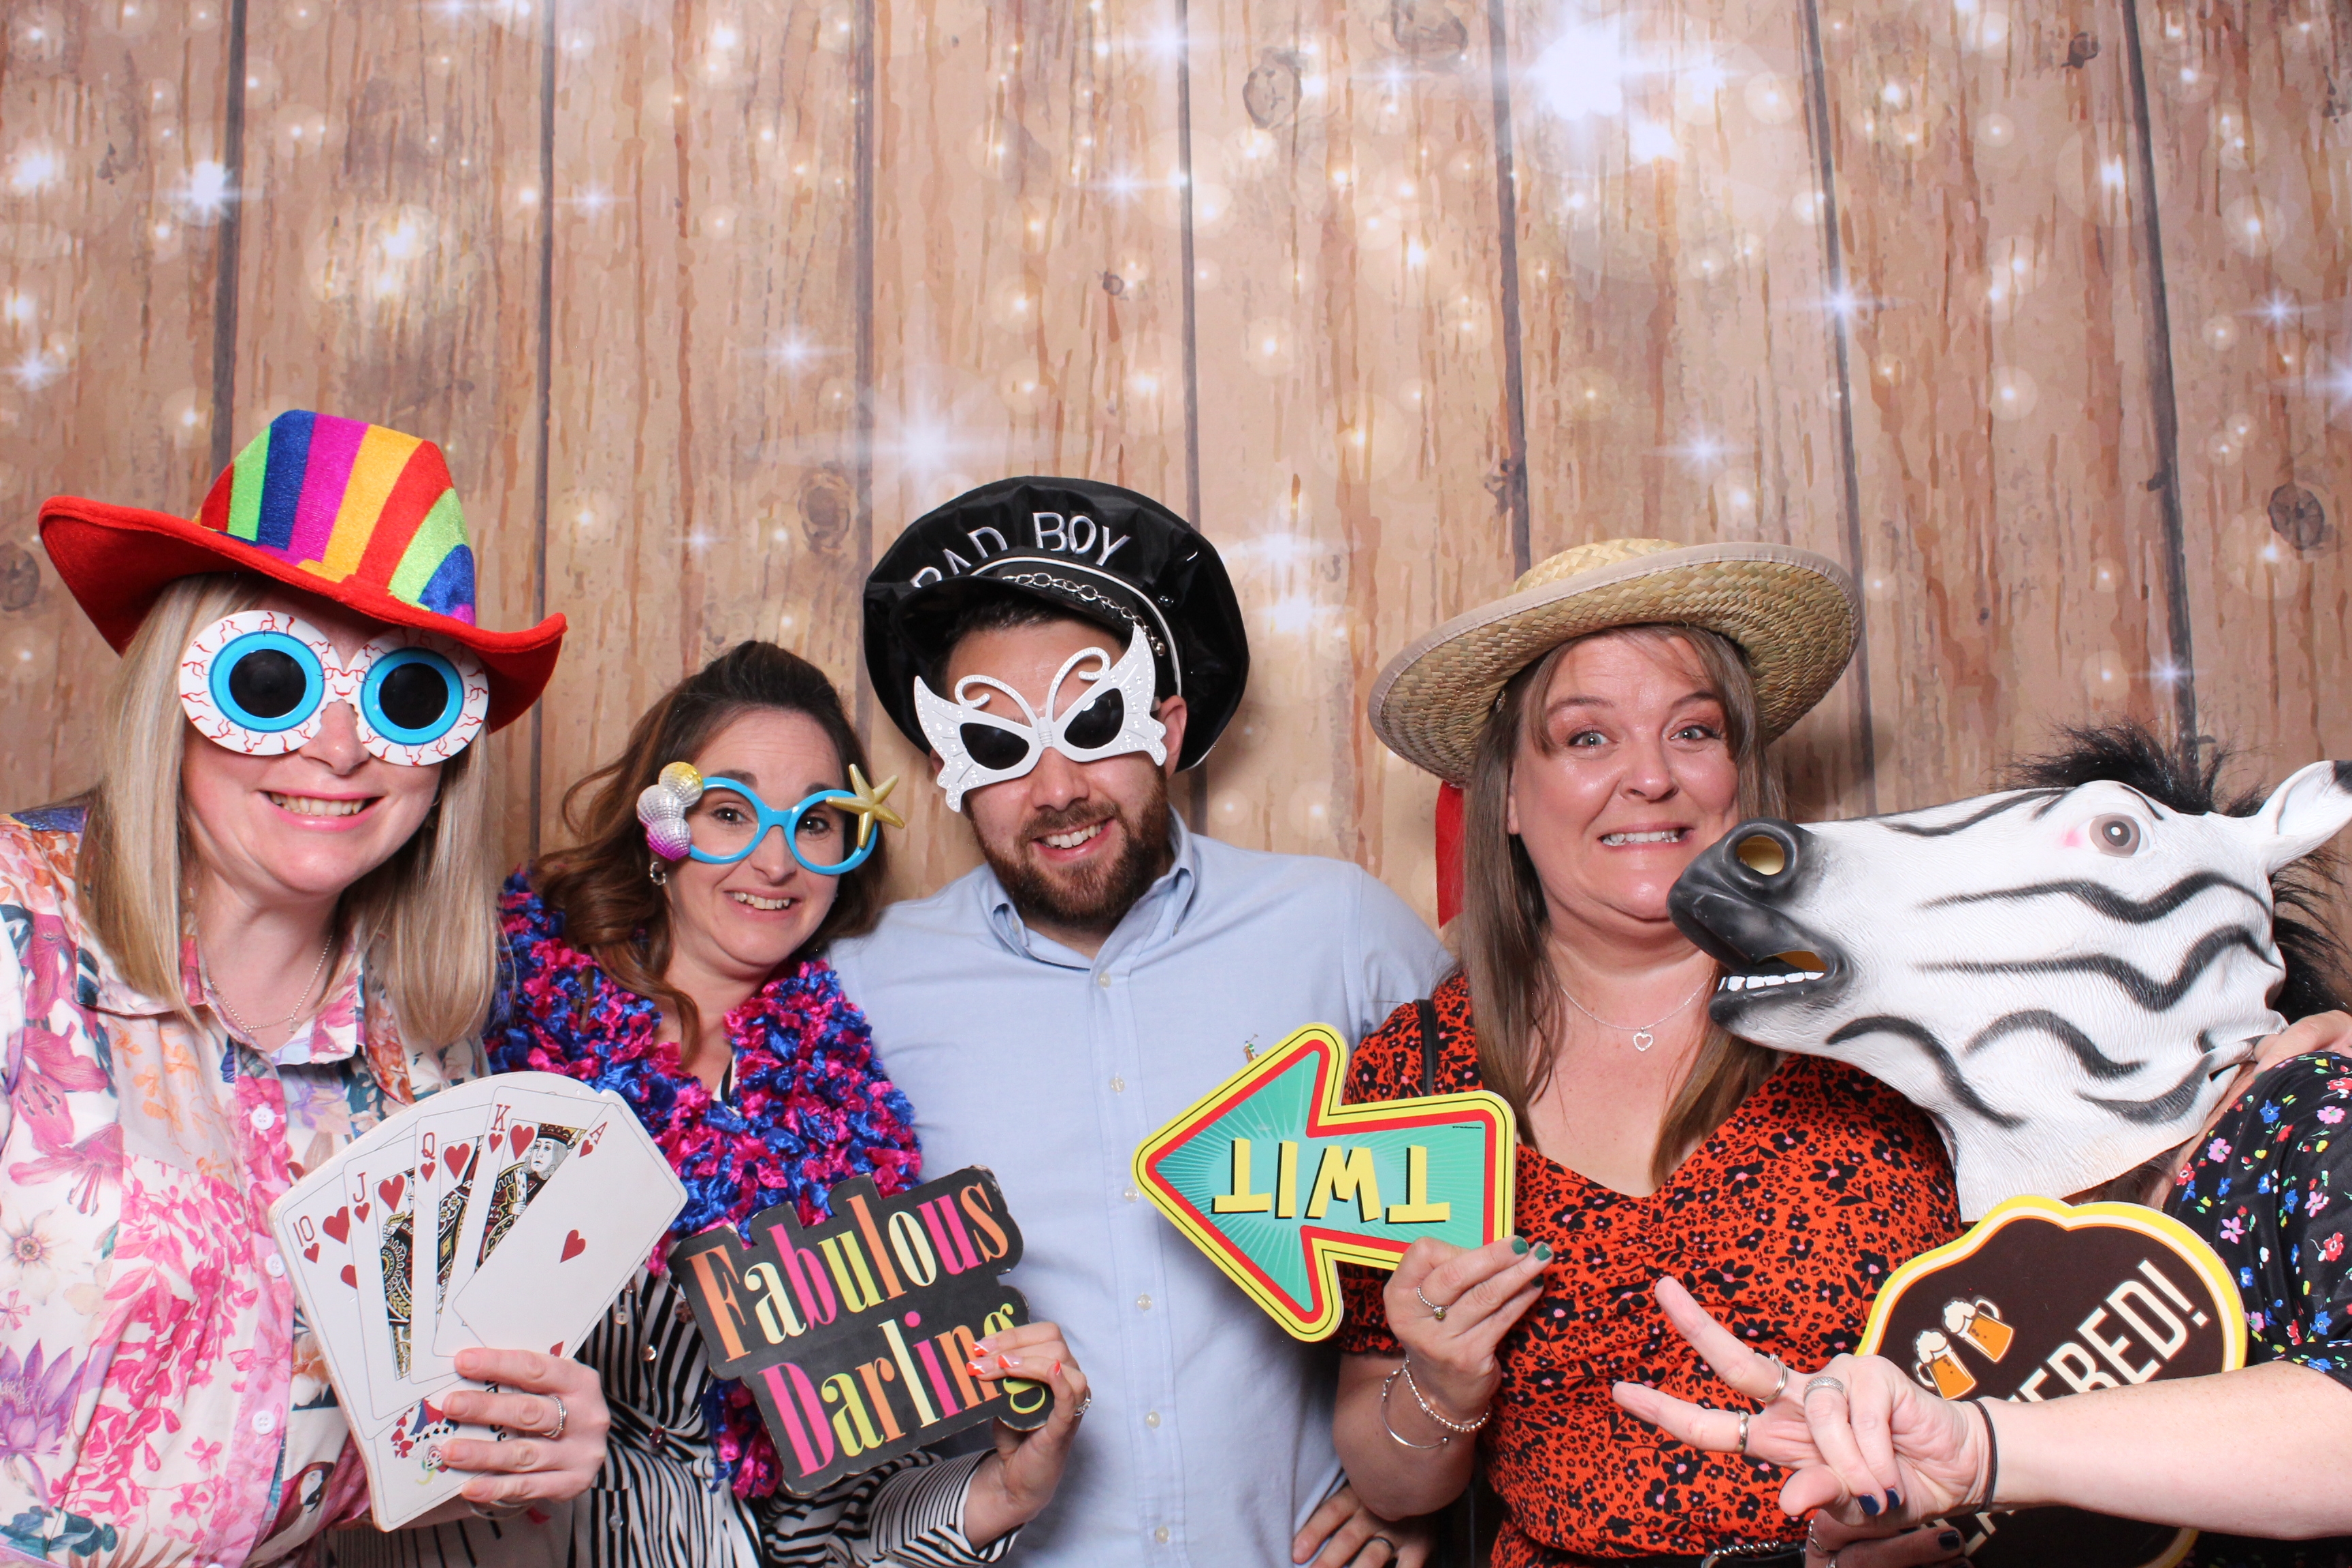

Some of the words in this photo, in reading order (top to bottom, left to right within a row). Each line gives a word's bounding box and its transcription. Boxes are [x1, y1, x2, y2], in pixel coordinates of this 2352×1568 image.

[1032, 512, 1131, 566] BOY
[492, 1104, 511, 1132] K
[589, 1121, 608, 1145] A
[421, 1132, 436, 1160] Q
[353, 1171, 367, 1203] J
[1211, 1137, 1450, 1224] TWIT
[293, 1215, 315, 1247] 10
[685, 1181, 1009, 1362] Fabulous
[757, 1303, 1046, 1477] Darling
